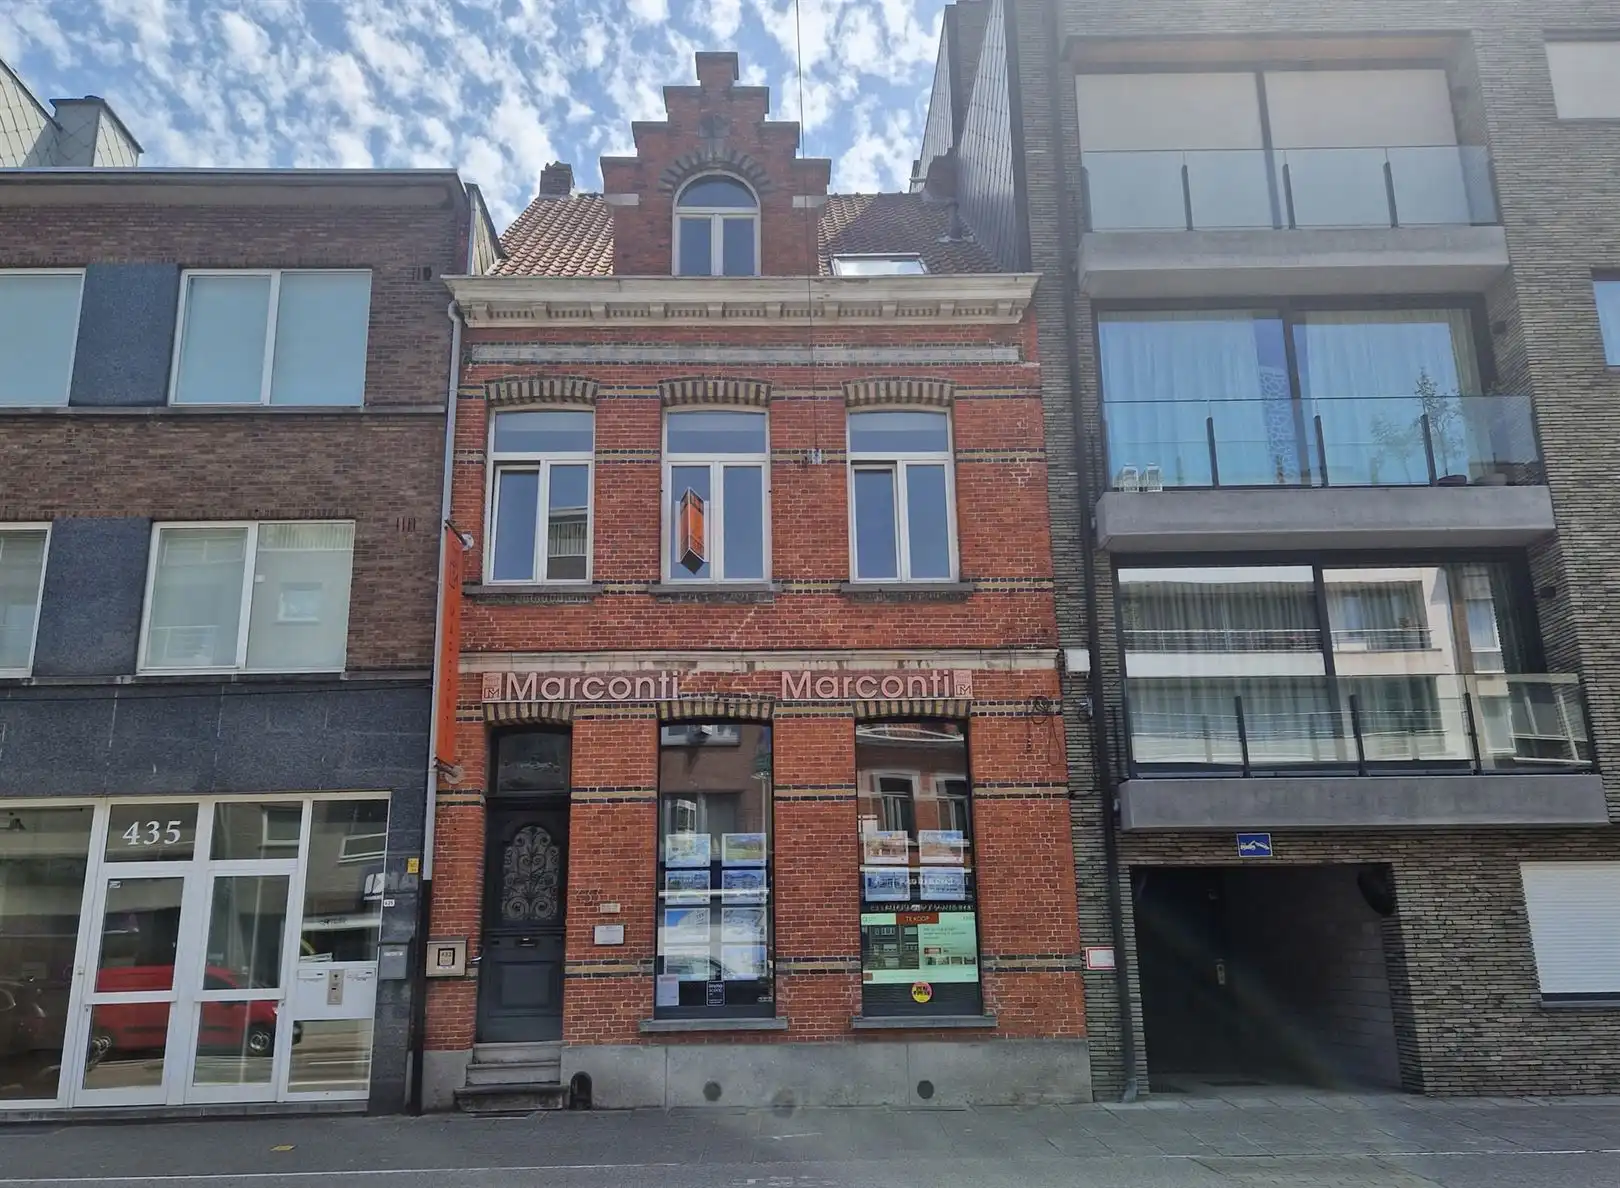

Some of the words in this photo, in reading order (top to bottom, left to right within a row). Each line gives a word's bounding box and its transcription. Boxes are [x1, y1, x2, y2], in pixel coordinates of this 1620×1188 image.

[506, 670, 679, 700] Marconti
[781, 669, 950, 699] Marconti
[122, 820, 182, 845] 435
